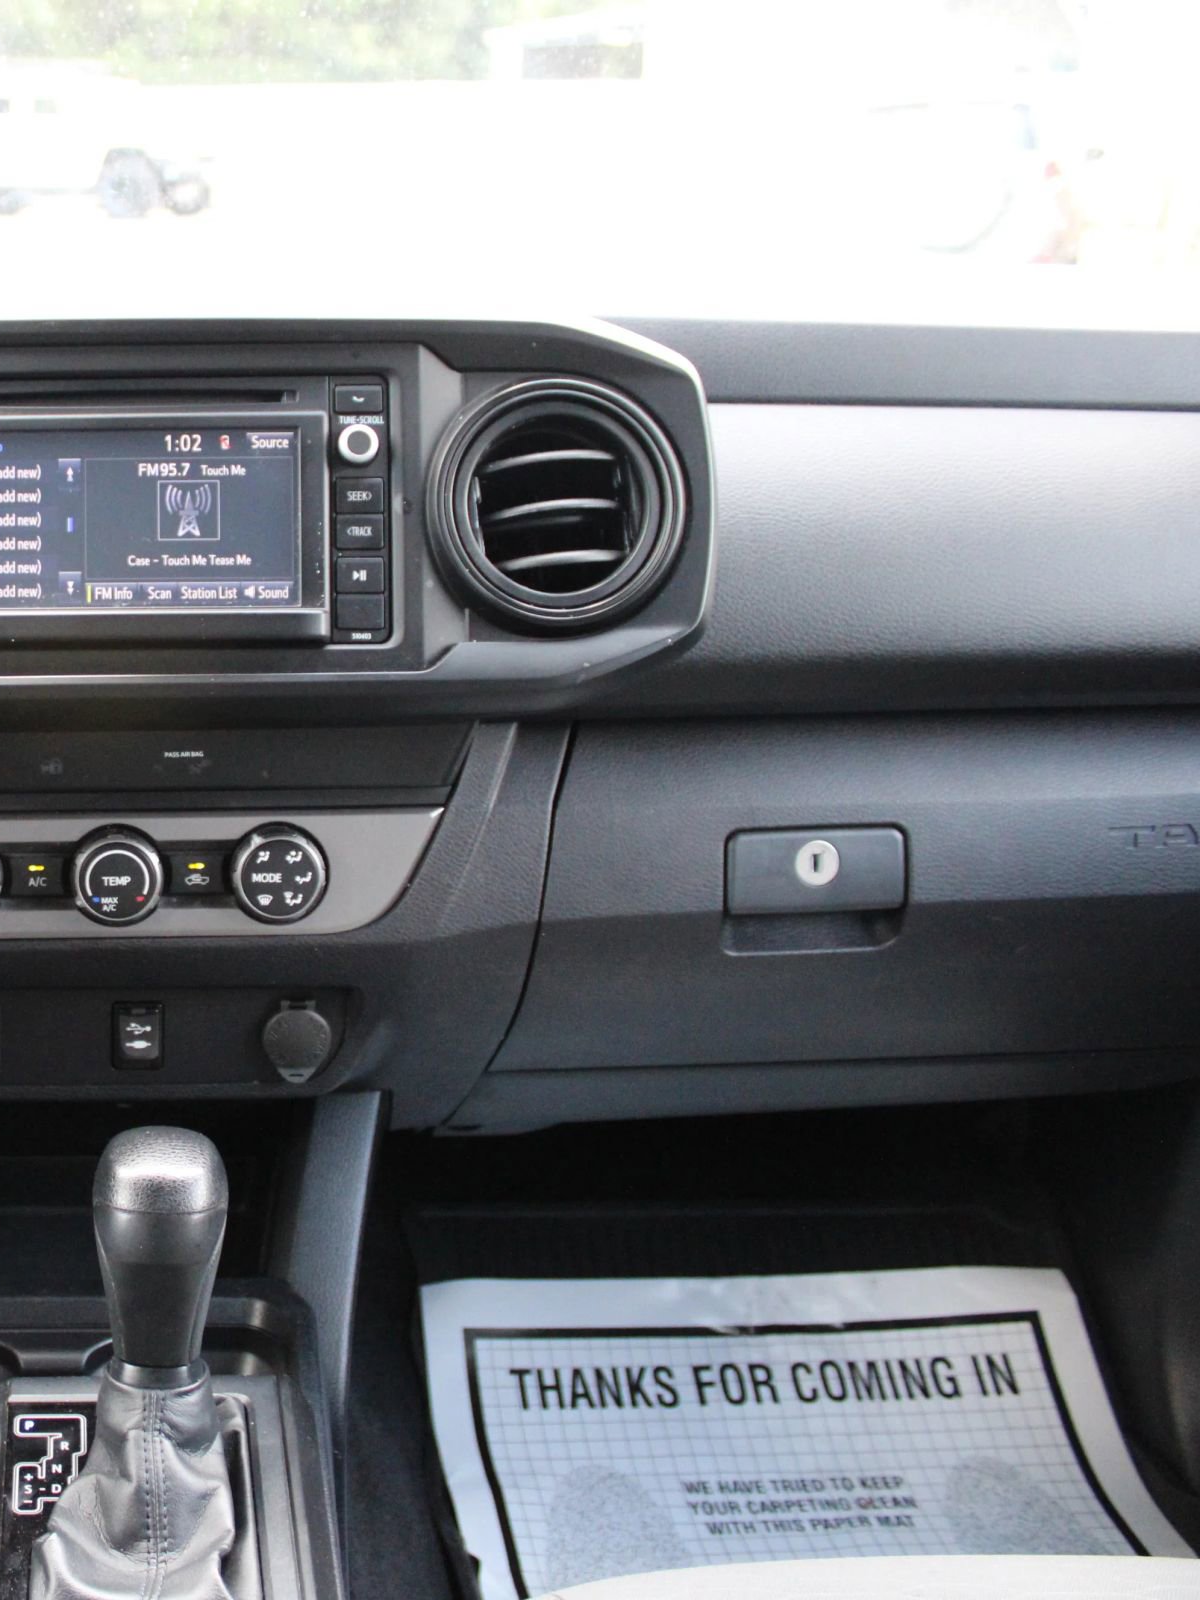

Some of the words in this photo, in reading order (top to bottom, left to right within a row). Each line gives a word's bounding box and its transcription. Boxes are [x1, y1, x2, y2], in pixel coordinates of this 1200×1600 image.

[165, 434, 202, 452] 1:02
[251, 436, 289, 449] Source
[17, 464, 42, 481] new)
[200, 465, 229, 476] Touch
[230, 465, 246, 476] Me
[17, 488, 42, 505] new)
[17, 512, 42, 529] new)
[17, 535, 42, 552] new)
[128, 555, 150, 566] Case
[162, 555, 190, 566] Touch
[192, 555, 207, 566] Me
[209, 555, 234, 566] Tease
[236, 555, 252, 566] Me
[17, 559, 42, 576] new)
[17, 583, 42, 600] new)
[95, 587, 112, 599] FM
[114, 587, 133, 599] Info
[148, 588, 172, 600] Scan
[181, 587, 215, 599] Station
[218, 587, 237, 599] List
[258, 586, 289, 599] Sound
[28, 877, 47, 887] A/C
[102, 876, 131, 886] TEMP
[252, 873, 282, 883] MODE
[102, 904, 116, 912] A/C
[509, 1366, 680, 1411] THANKS
[692, 1361, 779, 1408] FOR
[791, 1355, 960, 1403] COMING
[974, 1352, 1020, 1396] IN
[24, 1420, 34, 1430] P
[60, 1441, 69, 1450] R
[51, 1464, 62, 1474] N
[24, 1484, 32, 1494] S
[51, 1484, 61, 1494] D
[683, 1480, 713, 1495] WE
[717, 1479, 768, 1494] HAVE
[770, 1478, 825, 1494] TRIED
[829, 1477, 855, 1491] TO
[858, 1475, 904, 1491] KEEP
[686, 1501, 741, 1515] YOUR
[747, 1498, 851, 1515] CARPETING
[856, 1496, 918, 1510] CLEAN
[706, 1520, 757, 1535] WITH
[762, 1519, 806, 1533] THIS
[809, 1515, 872, 1532] PAPER
[876, 1514, 917, 1528] MAT
